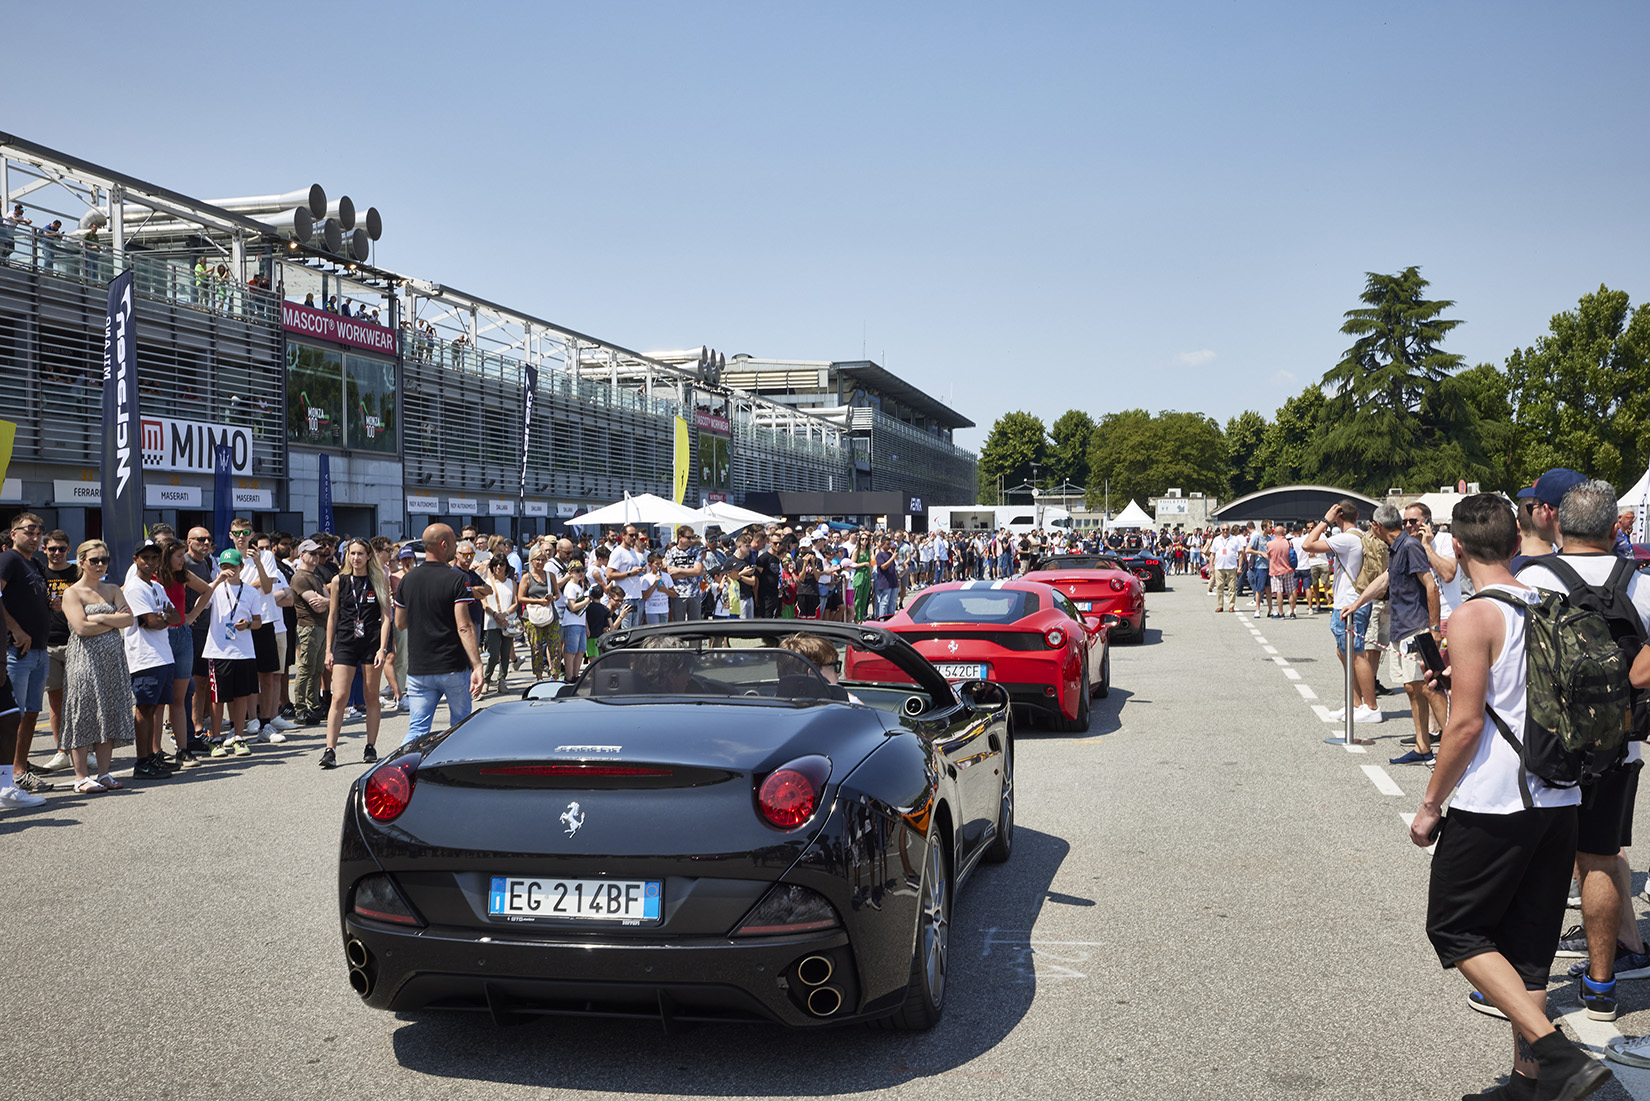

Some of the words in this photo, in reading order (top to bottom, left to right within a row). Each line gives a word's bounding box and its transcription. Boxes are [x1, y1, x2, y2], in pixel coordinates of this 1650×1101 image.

[336, 320, 394, 350] WORKWEAR
[308, 418, 319, 431] 100
[365, 426, 376, 438] 100
[170, 422, 248, 471] MIMO
[80, 470, 93, 482] 33
[161, 491, 189, 501] MASERATI
[236, 494, 261, 503] MASERATI
[945, 665, 980, 677] 542CF
[509, 881, 542, 911] EG
[552, 882, 641, 914] 214BF
